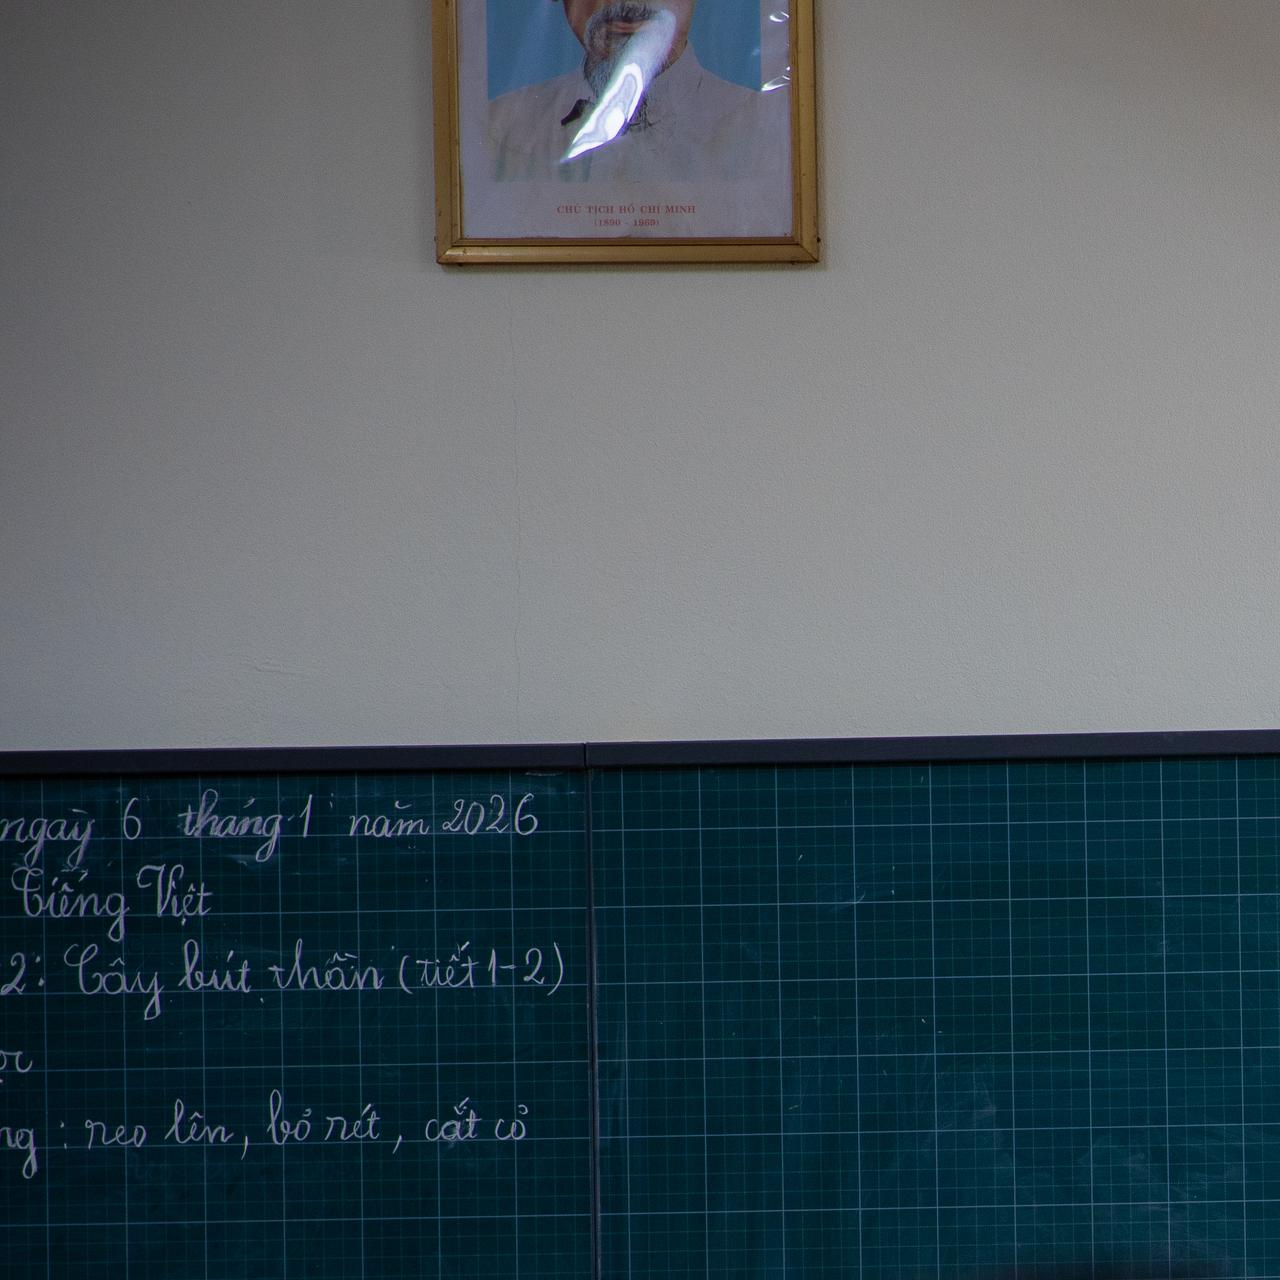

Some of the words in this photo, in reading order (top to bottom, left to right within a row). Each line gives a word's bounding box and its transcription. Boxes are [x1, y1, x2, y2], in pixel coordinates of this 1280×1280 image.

[664, 204, 696, 215] MINH
[0, 806, 97, 870] ngày
[123, 798, 141, 840] 6
[178, 789, 283, 862] tháng
[349, 801, 431, 837] năm
[442, 793, 538, 835] 2026
[12, 866, 130, 942] Tiếng
[136, 864, 212, 925] Việt
[64, 940, 164, 1020] Cây
[178, 939, 251, 993] bút
[397, 941, 477, 994] (tiết
[85, 1120, 146, 1149] reo
[267, 1089, 311, 1144] bỏ
[495, 1105, 528, 1140] cỏ
